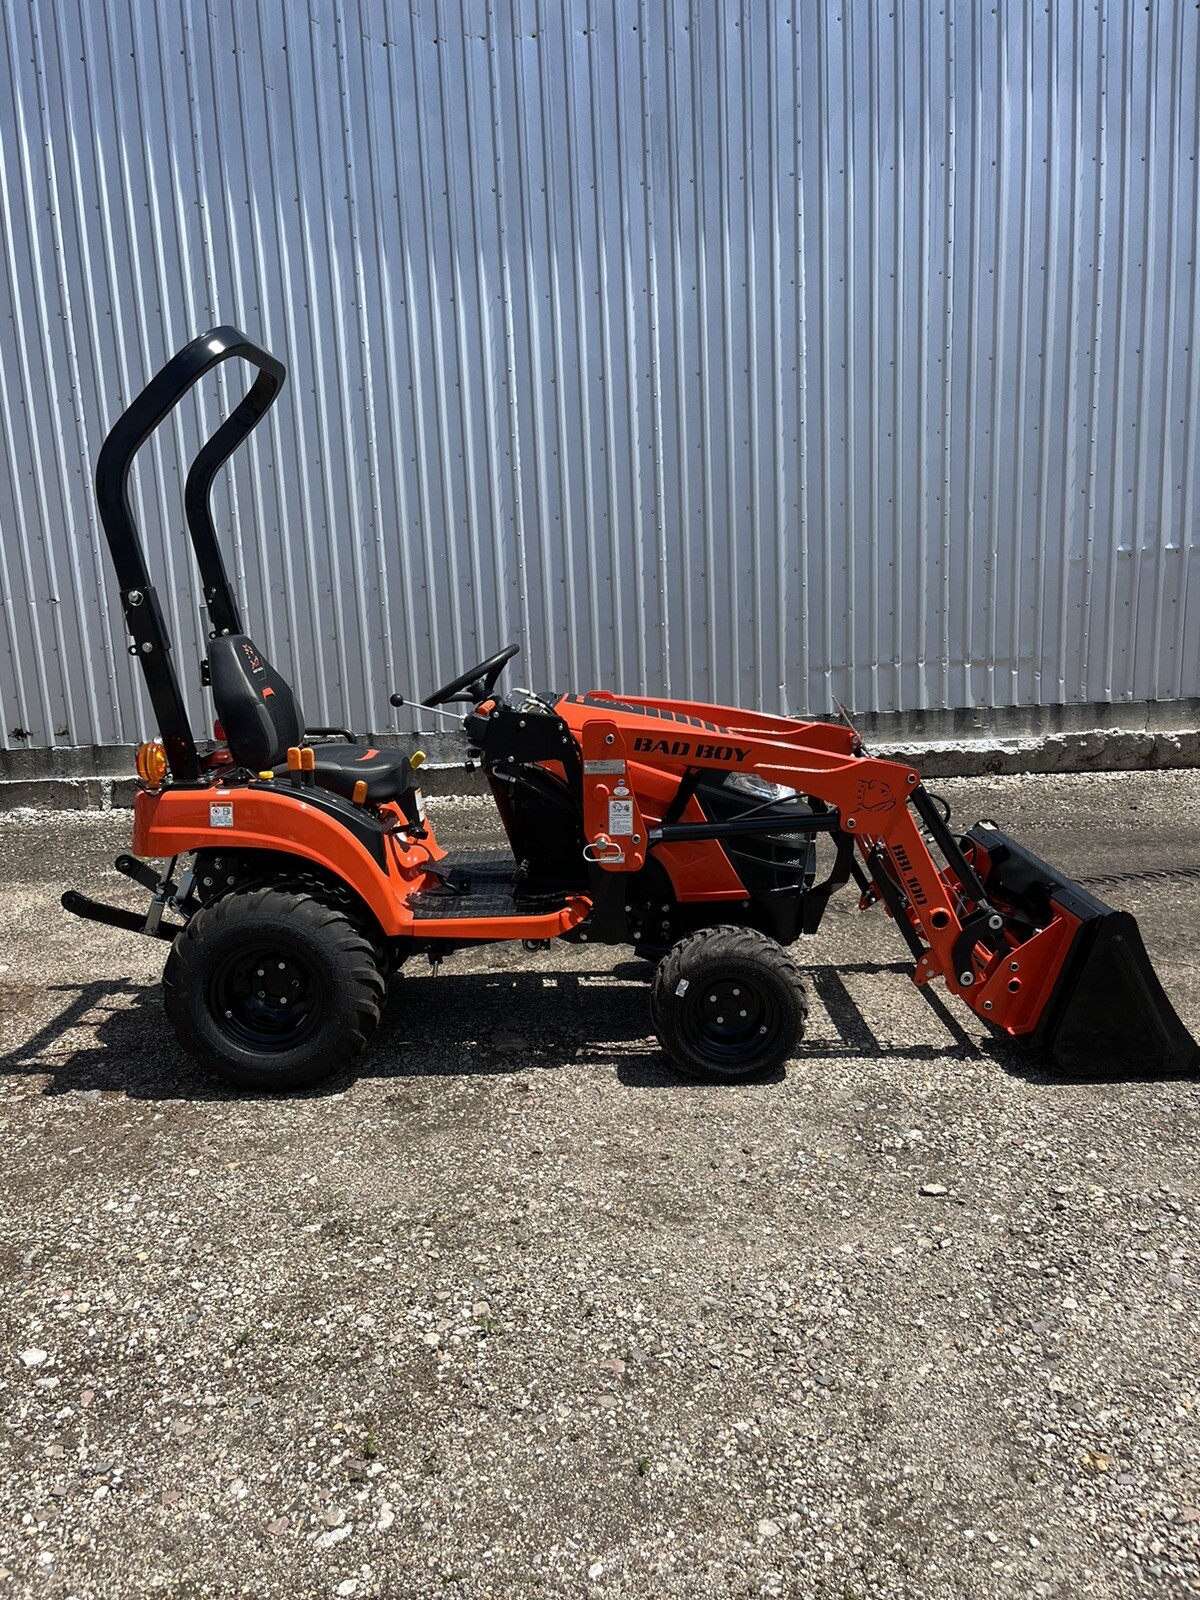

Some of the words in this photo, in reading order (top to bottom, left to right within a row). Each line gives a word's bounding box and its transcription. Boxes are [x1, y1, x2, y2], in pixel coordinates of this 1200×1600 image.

[633, 737, 691, 756] BAD
[695, 744, 752, 762] BOY
[892, 844, 914, 877] BBL
[907, 876, 928, 906] 100
